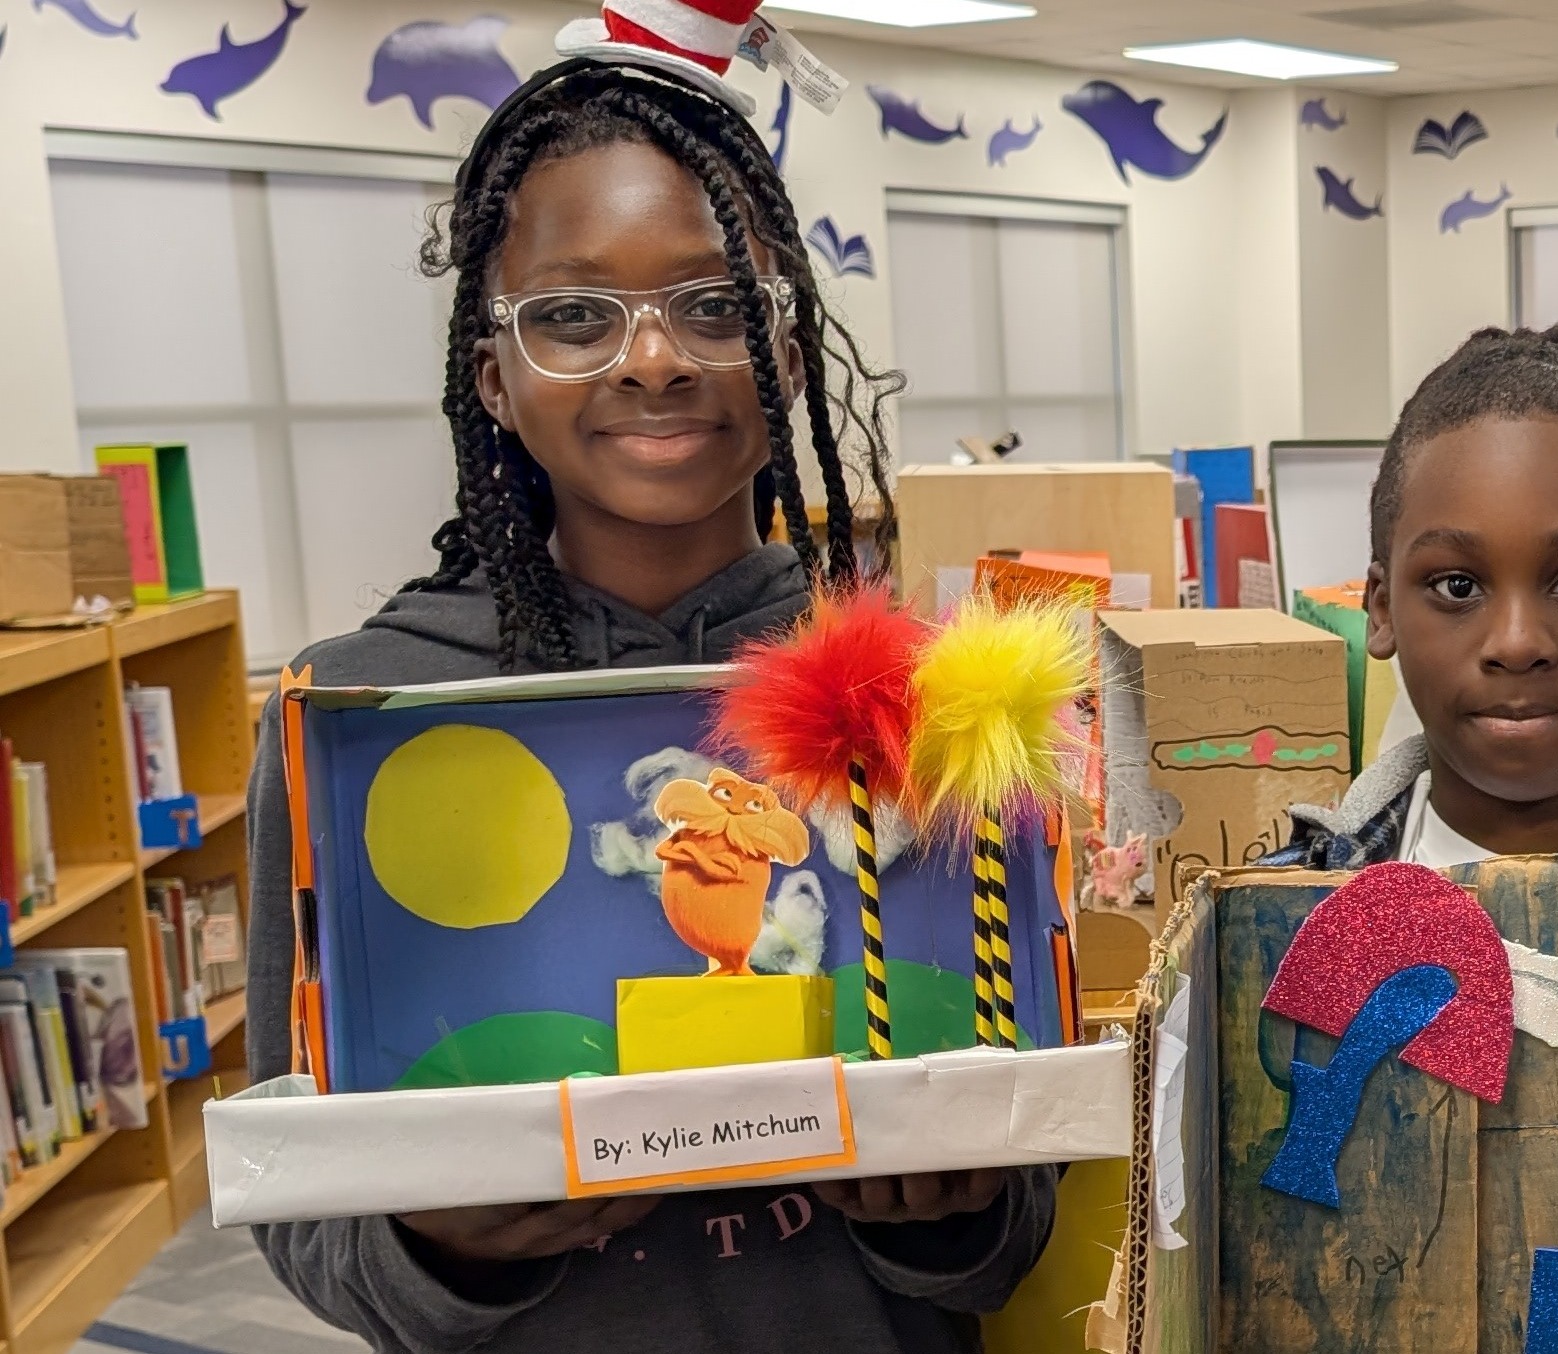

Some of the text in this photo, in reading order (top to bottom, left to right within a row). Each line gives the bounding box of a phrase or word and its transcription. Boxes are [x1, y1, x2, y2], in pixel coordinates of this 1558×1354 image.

[170, 809, 196, 844] T
[594, 1114, 821, 1164] By: Kylie Mitchum
